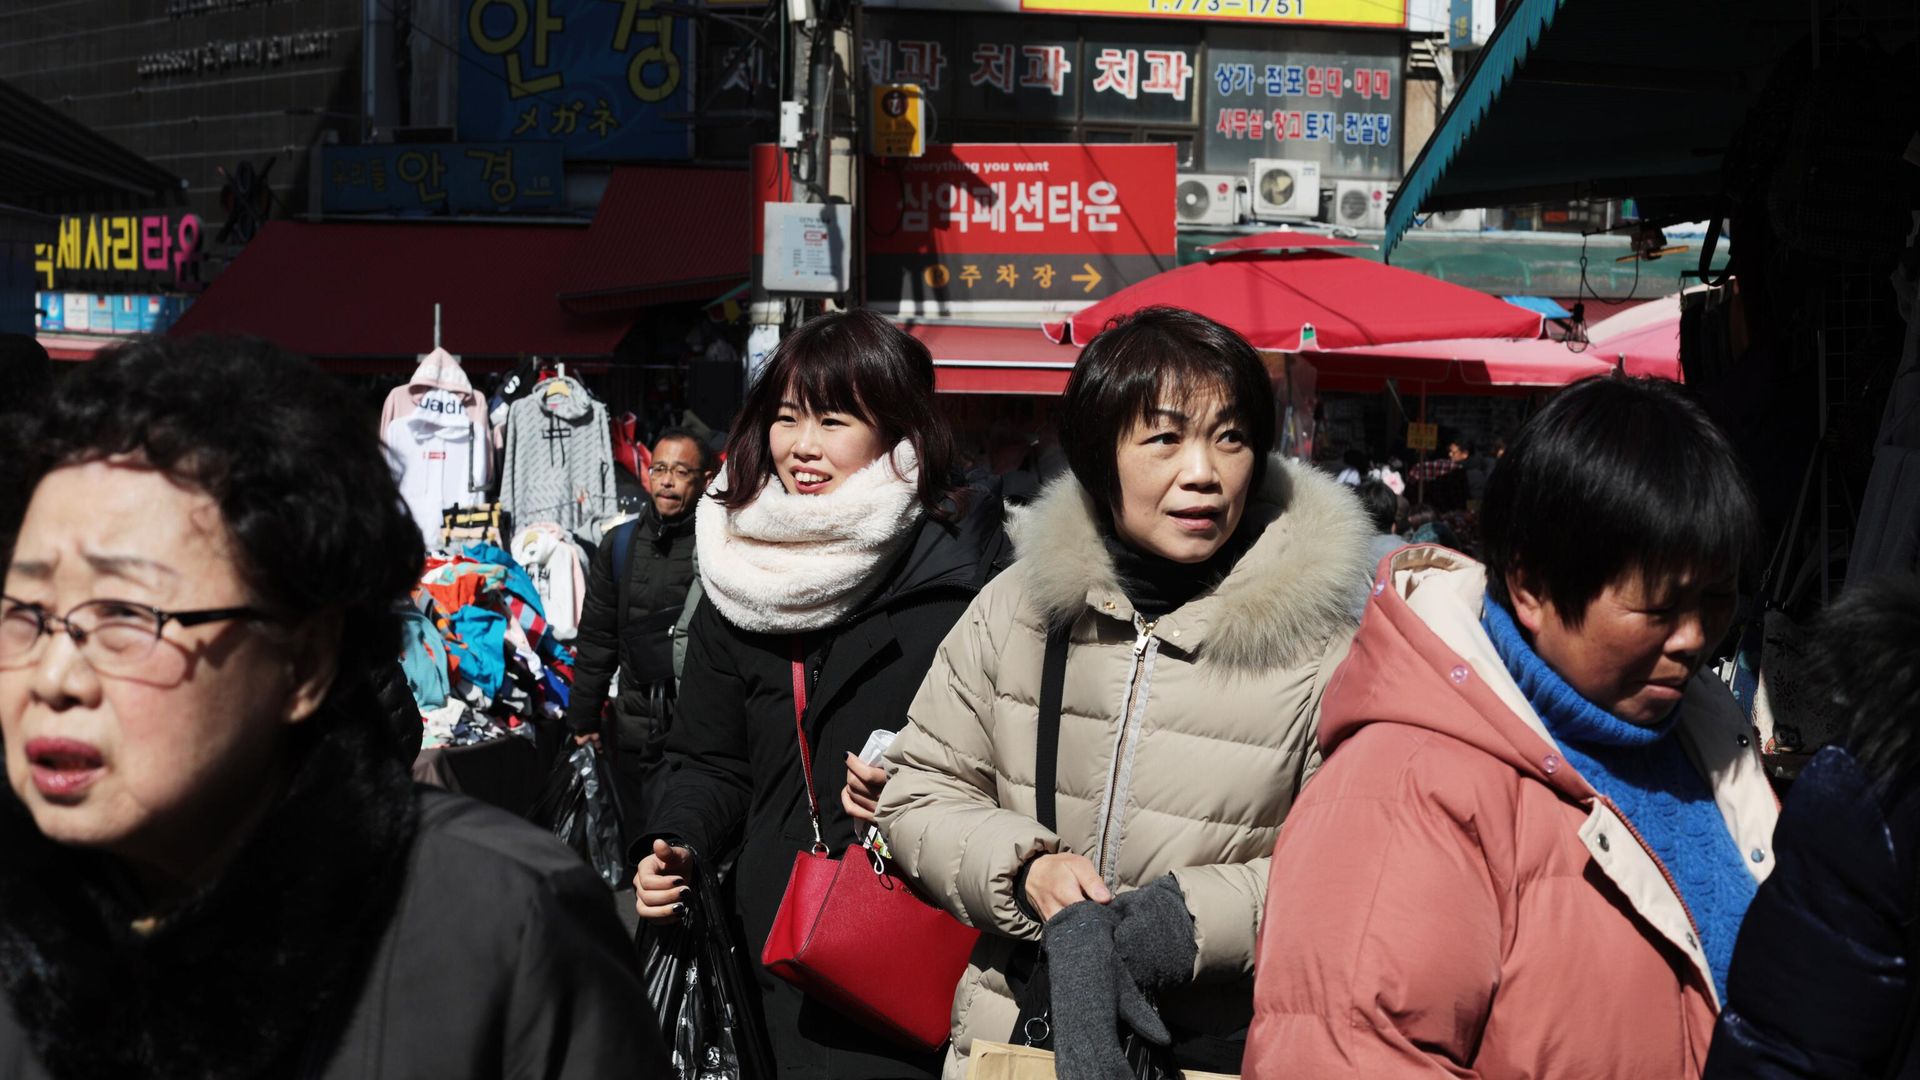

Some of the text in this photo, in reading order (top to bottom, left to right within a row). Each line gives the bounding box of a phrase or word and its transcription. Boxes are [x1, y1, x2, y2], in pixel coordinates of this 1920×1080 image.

[970, 42, 1070, 96] 치과
[1093, 48, 1192, 100] 치과
[514, 100, 619, 138] メガネ
[904, 160, 1050, 174] Everything you want
[897, 181, 1120, 233] 삼익패션타운
[959, 264, 1057, 288] 주차장
